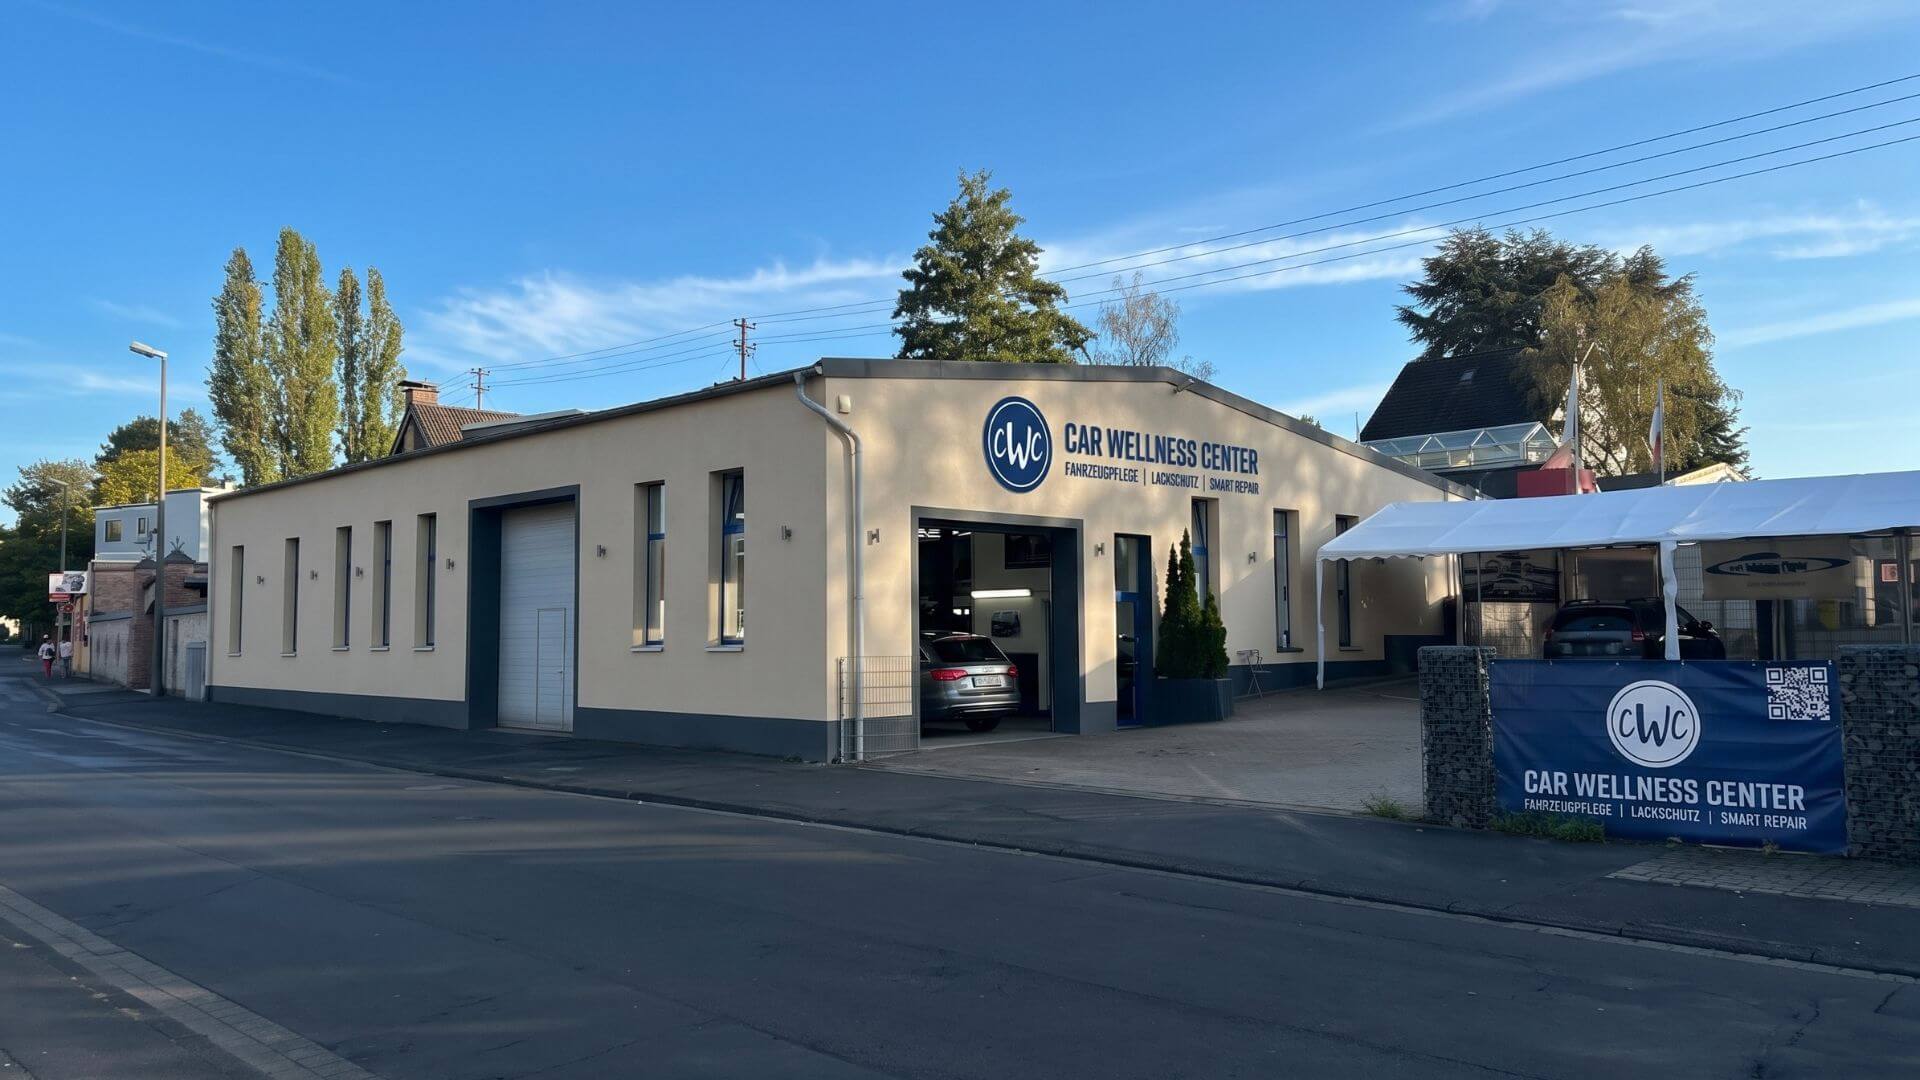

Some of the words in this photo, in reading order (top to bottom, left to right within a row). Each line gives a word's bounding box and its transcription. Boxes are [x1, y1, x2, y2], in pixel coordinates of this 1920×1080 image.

[1064, 422, 1103, 458] CAR
[1106, 428, 1197, 468] WELLNESS
[1201, 442, 1259, 475] CENTER
[1065, 461, 1139, 483] FAHRZEUGPFLEGE
[1151, 472, 1199, 489] LACKSCHUTZ
[1209, 477, 1234, 493] SMART
[1234, 479, 1259, 495] REPAIR
[1524, 769, 1568, 796] CAR
[1574, 772, 1699, 804] WELLNESS
[1706, 780, 1805, 811] CENTER
[1524, 798, 1612, 816] FAHRZEUGPFLEGE
[1631, 805, 1700, 822] LACKSCHUTZ
[1721, 811, 1761, 828] SMART
[1764, 814, 1807, 830] REPAIR
